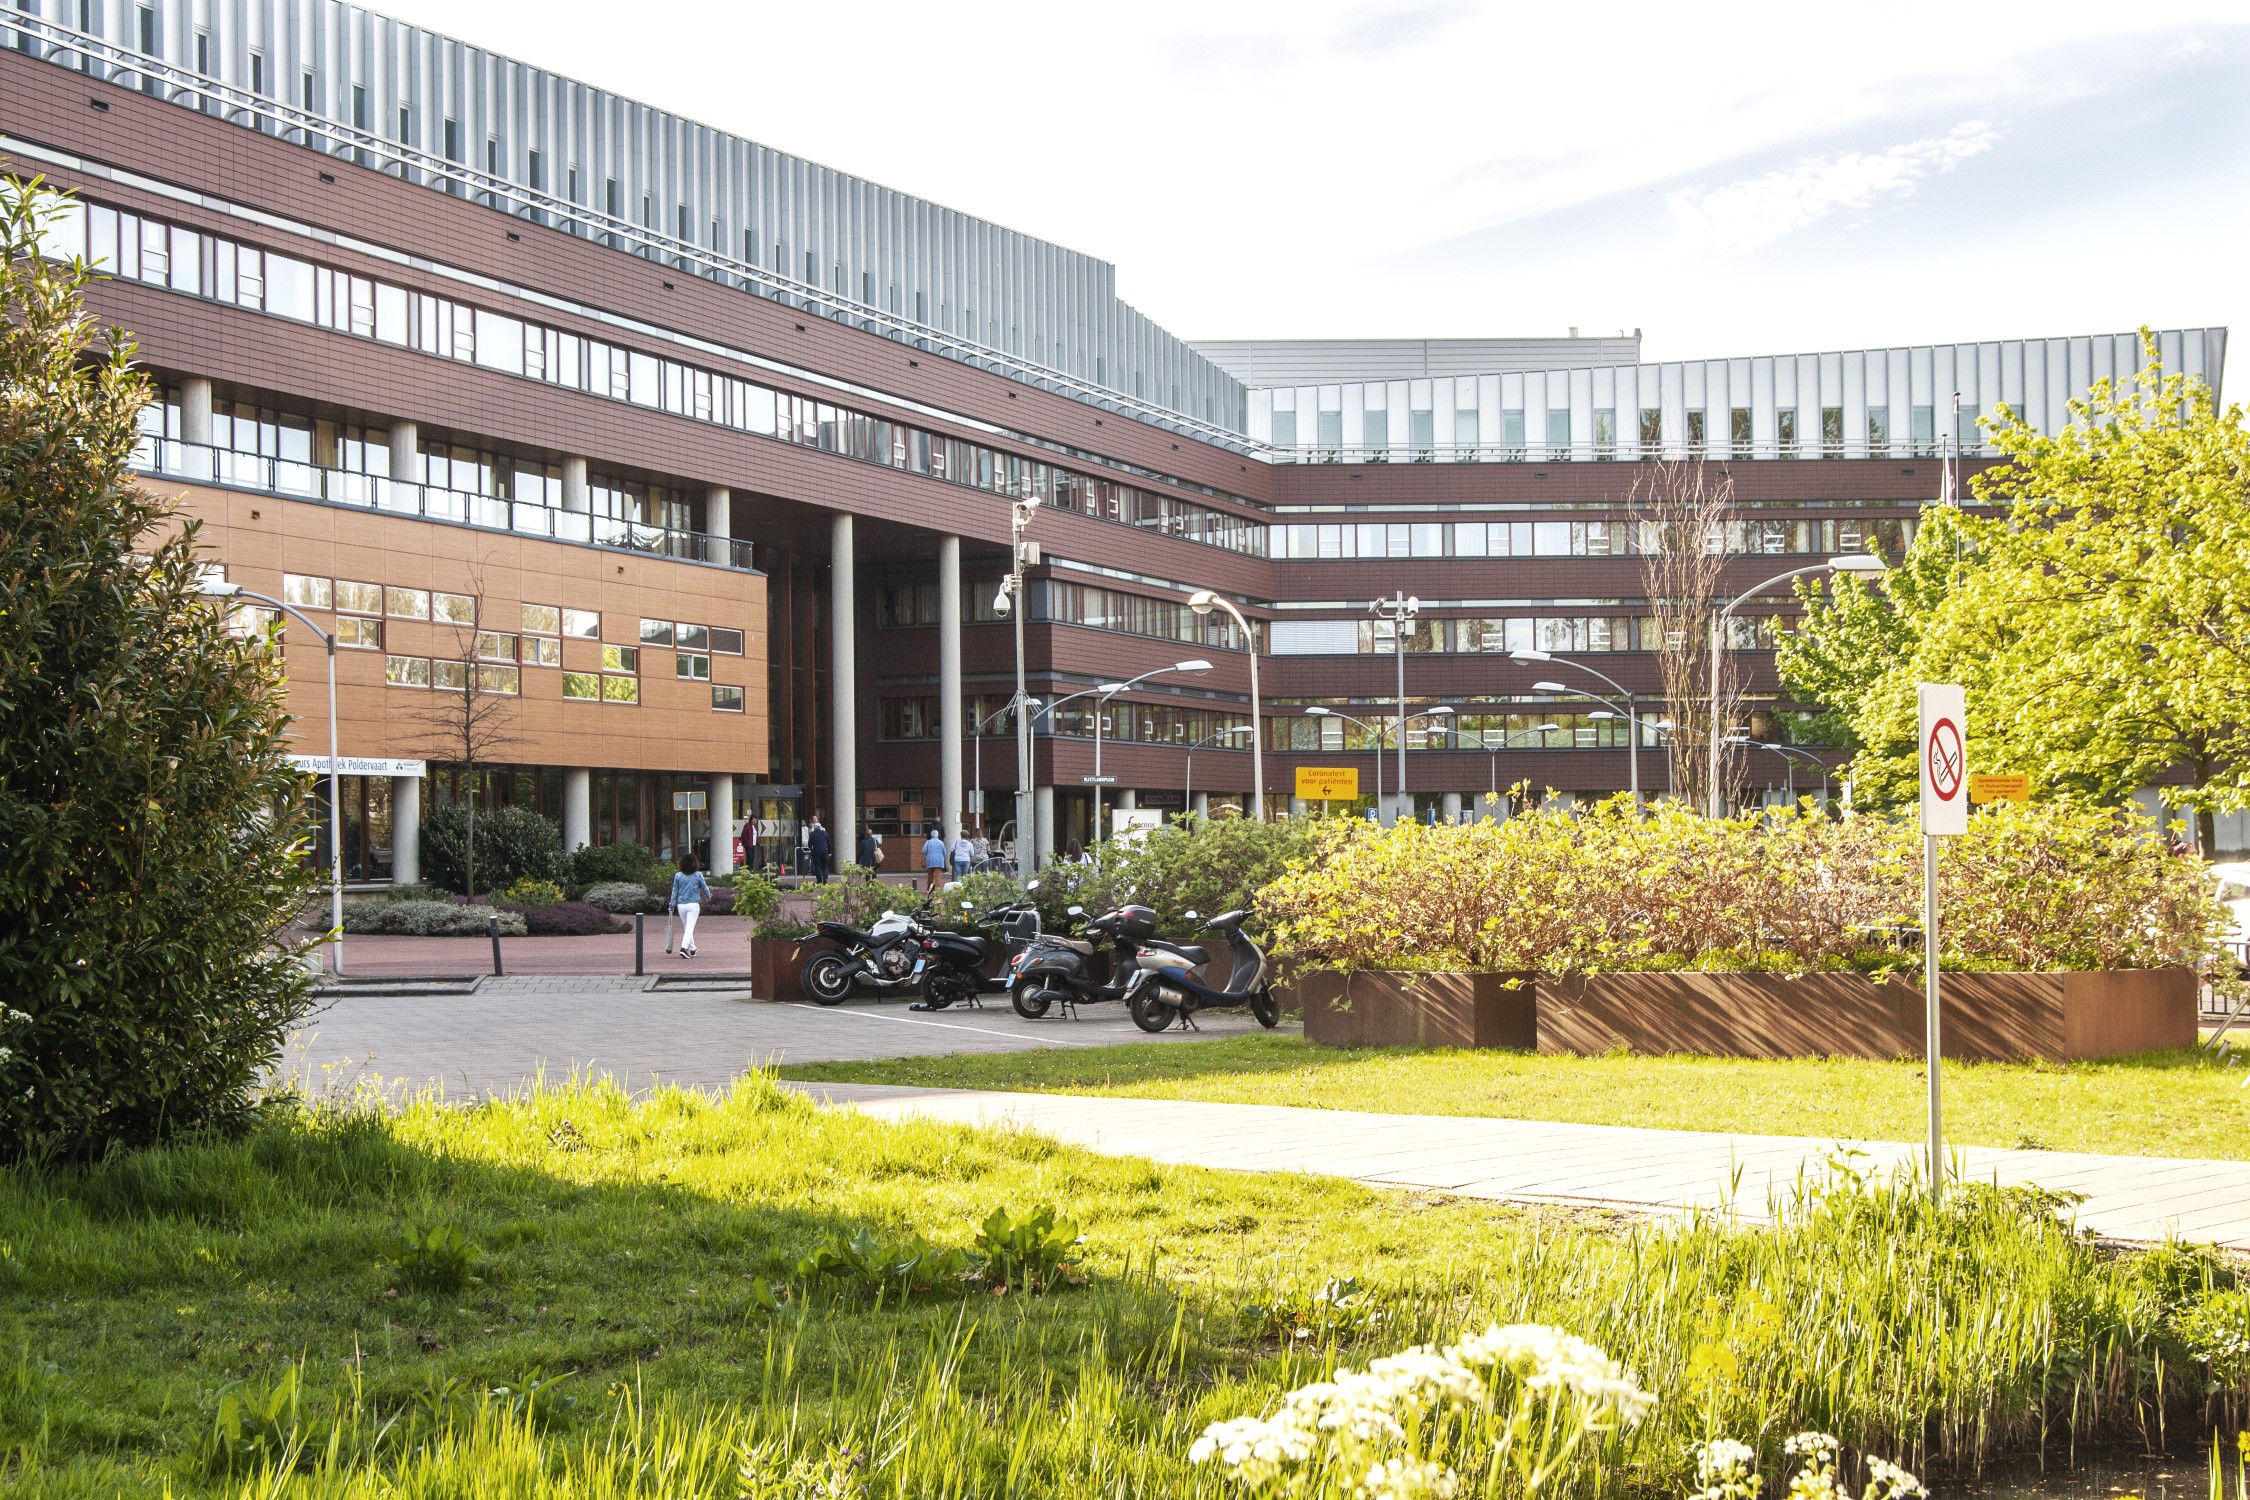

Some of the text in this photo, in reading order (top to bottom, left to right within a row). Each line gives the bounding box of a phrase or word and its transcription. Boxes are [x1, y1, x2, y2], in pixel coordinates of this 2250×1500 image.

[312, 757, 346, 771] Apothek
[348, 758, 388, 771] Poldervaart
[1319, 778, 1353, 786] patiënten
